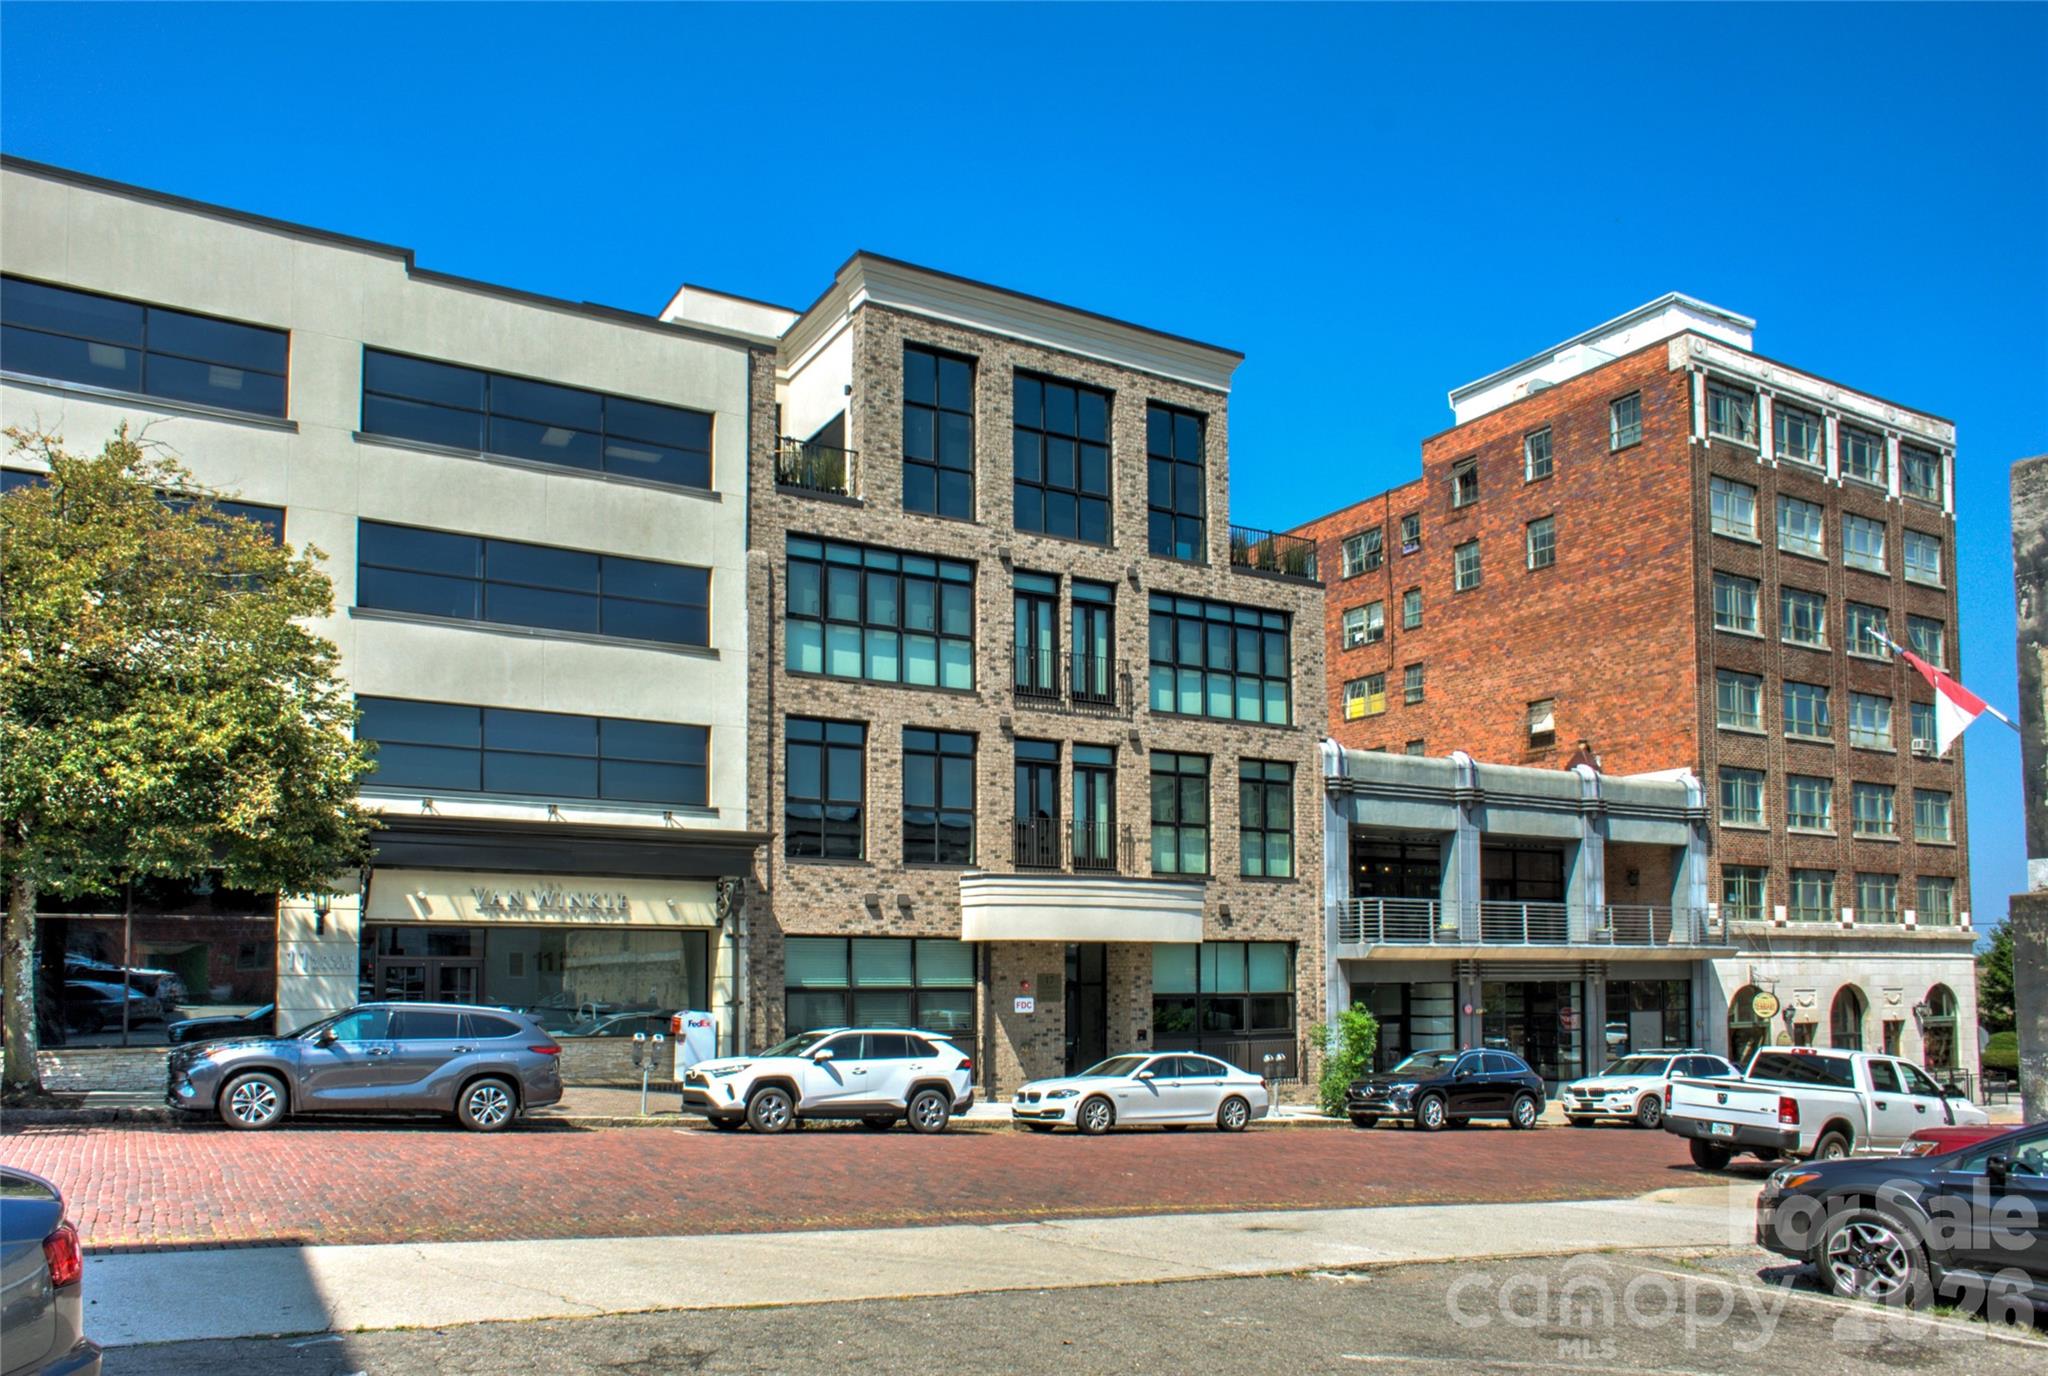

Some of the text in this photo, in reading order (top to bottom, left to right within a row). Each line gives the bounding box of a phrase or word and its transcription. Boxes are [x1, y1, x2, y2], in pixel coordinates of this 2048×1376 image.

[472, 887, 629, 910] VAN WINKLE
[1016, 1001, 1033, 1009] FDC
[687, 1019, 712, 1028] FedEx
